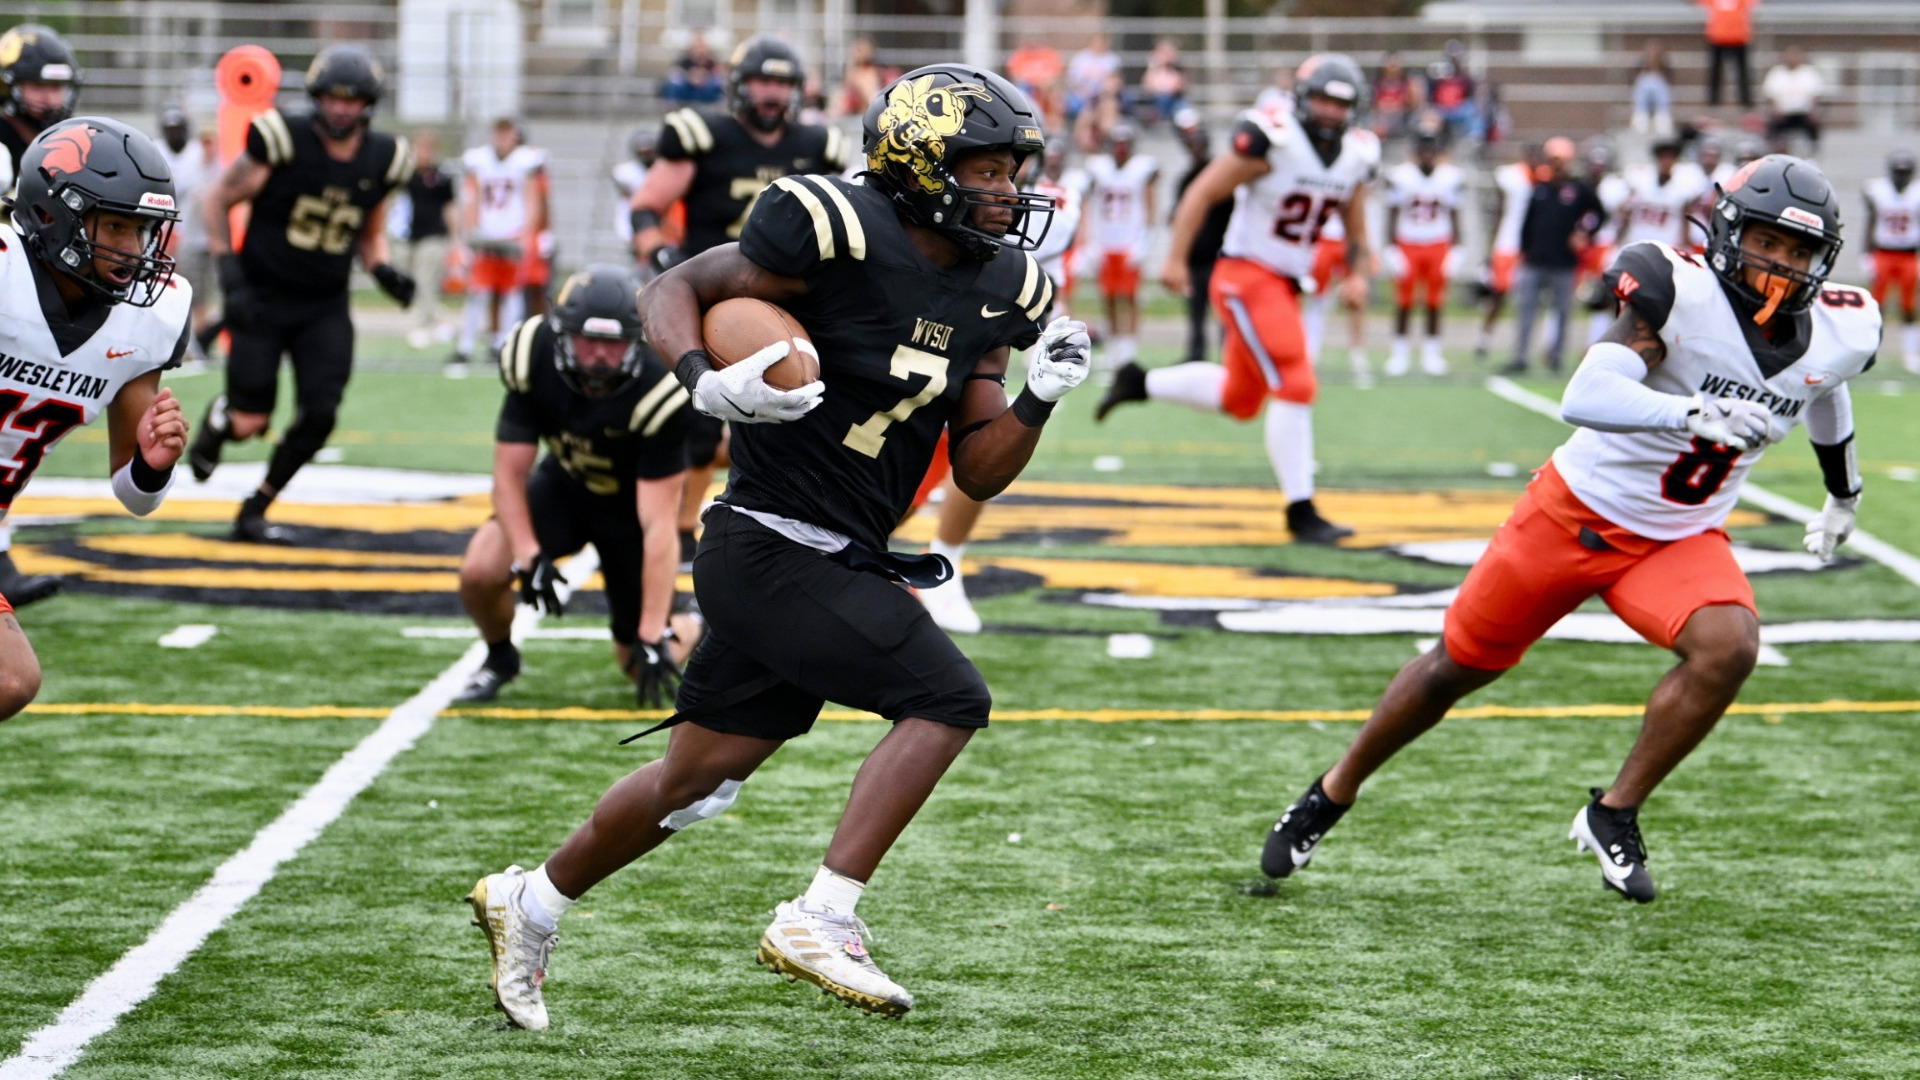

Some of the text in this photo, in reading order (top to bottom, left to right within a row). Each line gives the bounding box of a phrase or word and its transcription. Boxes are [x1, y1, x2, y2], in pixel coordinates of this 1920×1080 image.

[1024, 128, 1042, 140] STAT
[147, 196, 173, 207] Riddell
[286, 194, 362, 254] 56
[1618, 271, 1640, 297] W
[1821, 289, 1865, 309] 8
[911, 317, 954, 351] WVSU
[0, 353, 109, 400] WESLEYAN
[842, 344, 950, 460] 7
[1660, 434, 1745, 506] 8
